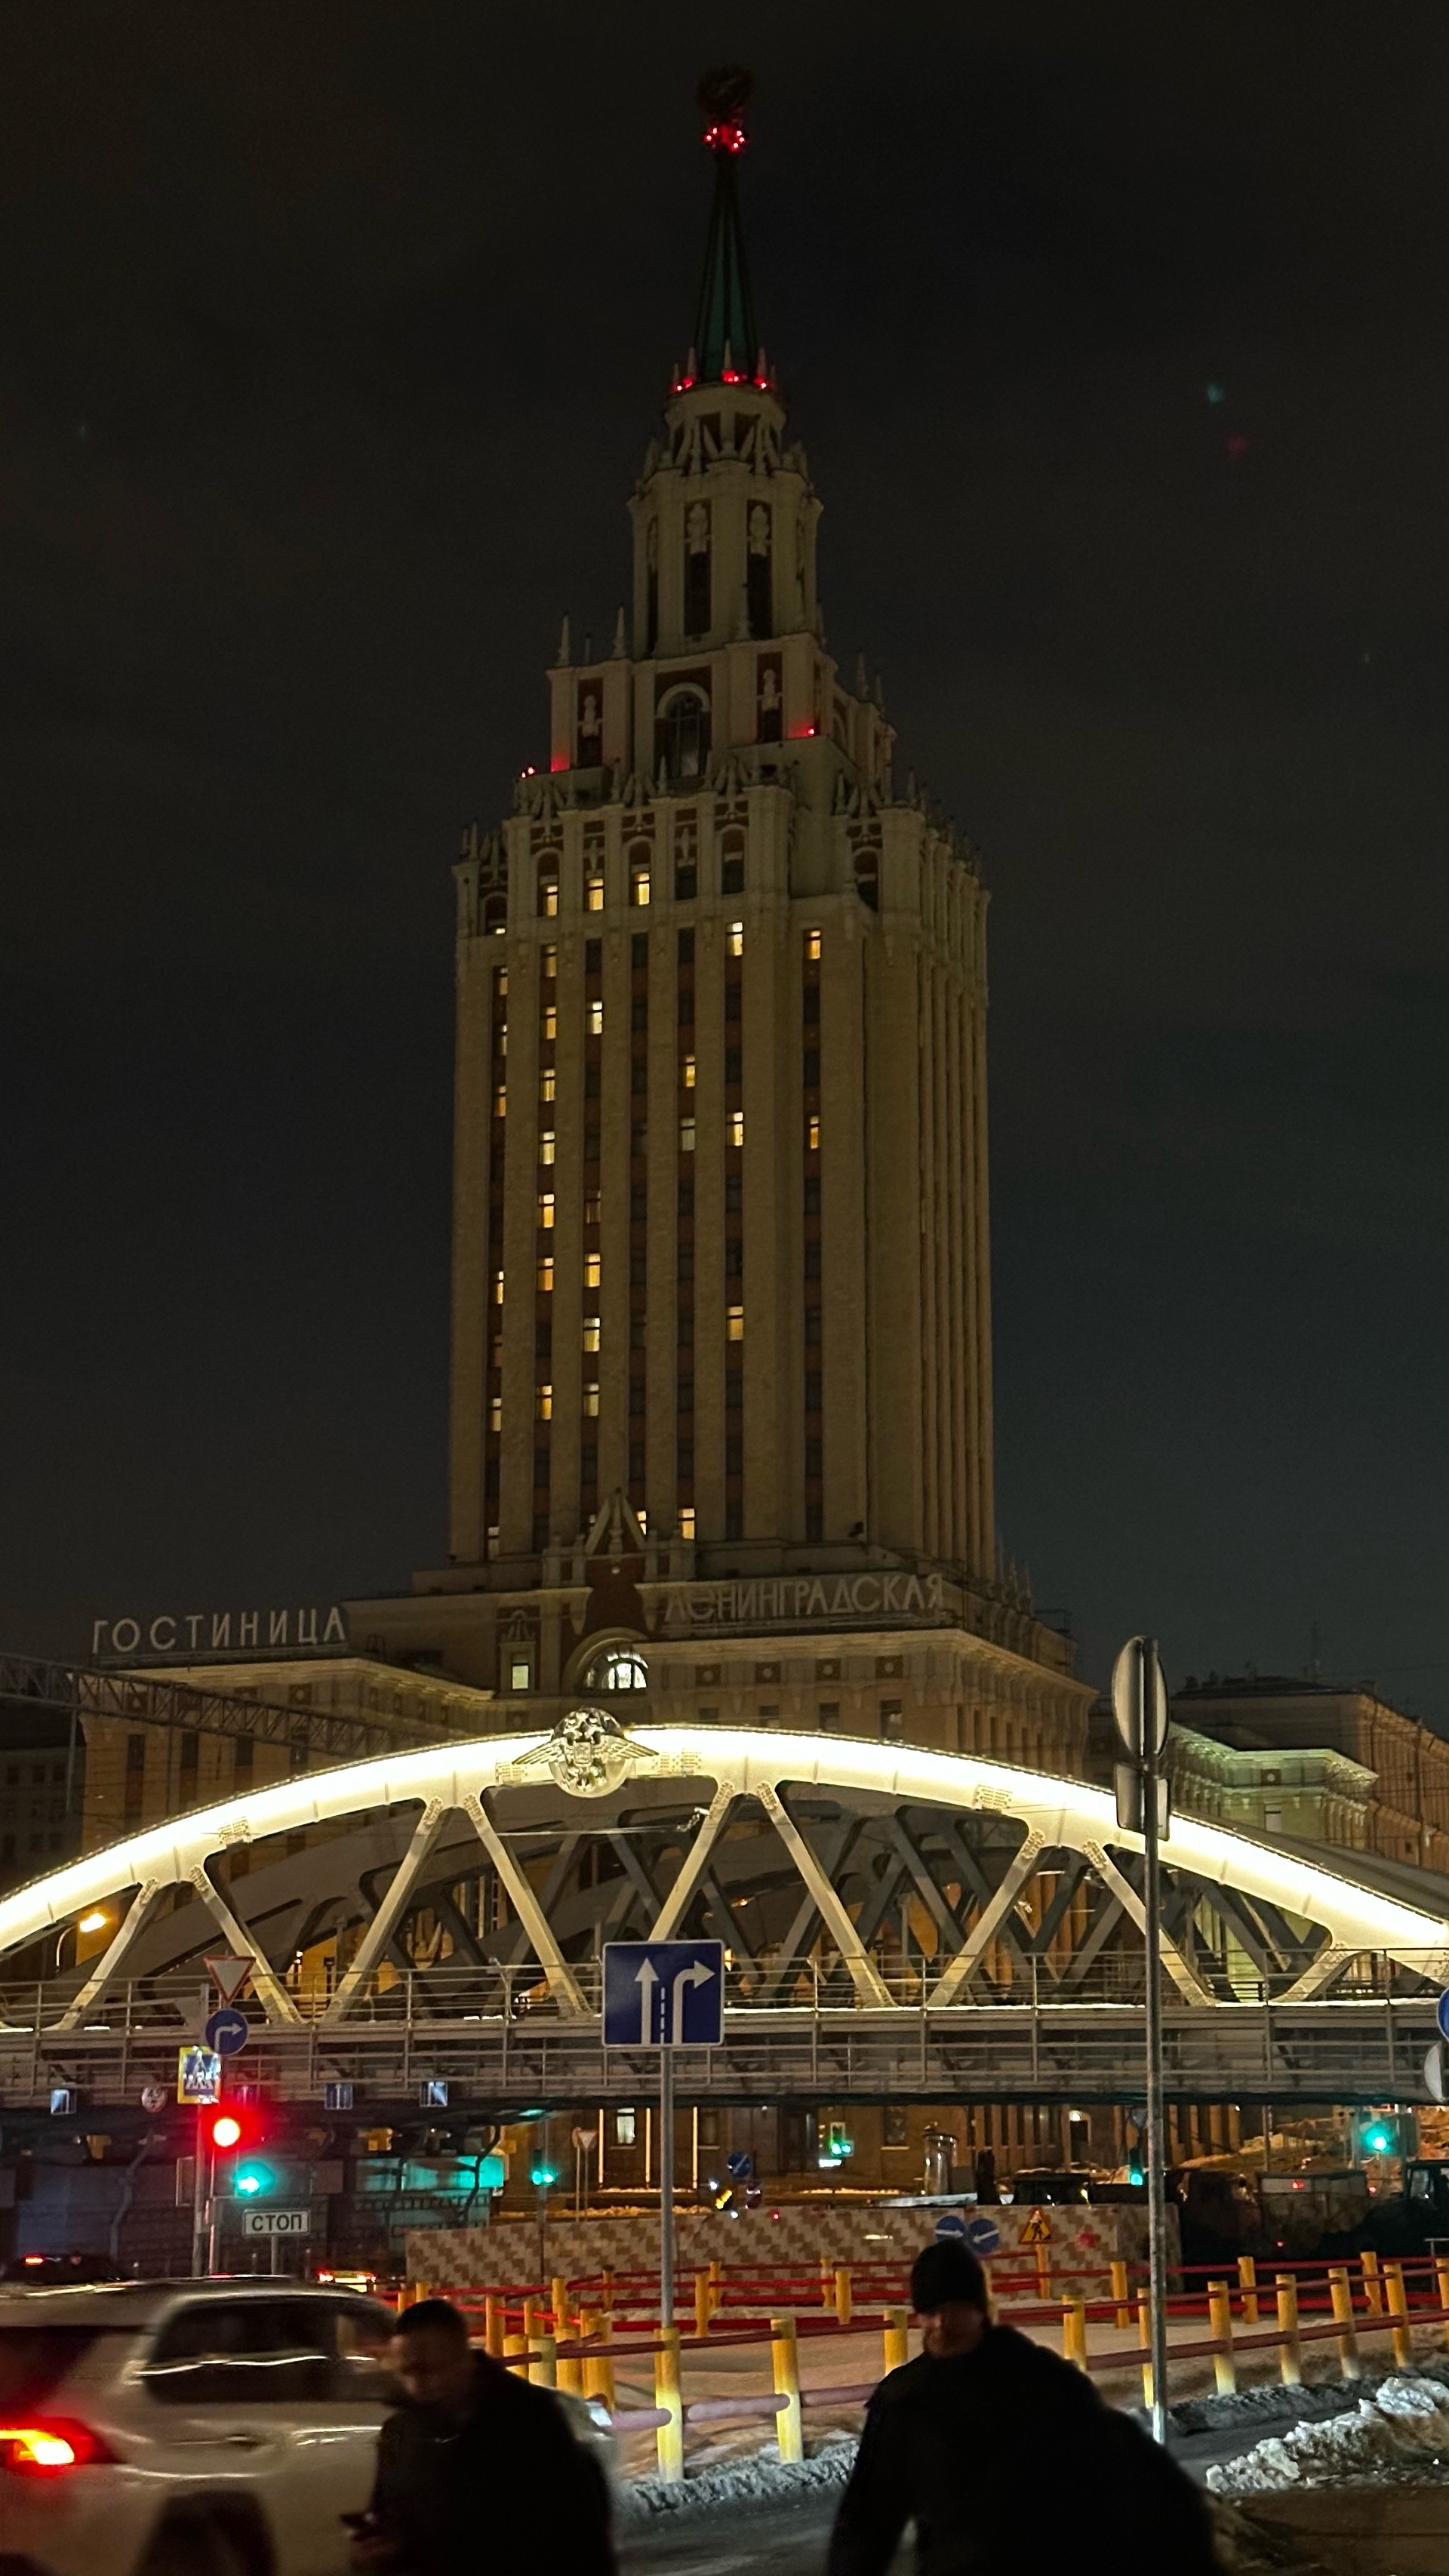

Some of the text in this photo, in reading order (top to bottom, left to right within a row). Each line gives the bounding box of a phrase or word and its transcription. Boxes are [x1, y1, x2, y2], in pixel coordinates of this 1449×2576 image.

[664, 1573, 943, 1621] ЛЕНИНГРАДСКАЯ
[91, 1607, 346, 1654] ГОСТИНИЦА
[252, 2214, 301, 2231] СТОП
